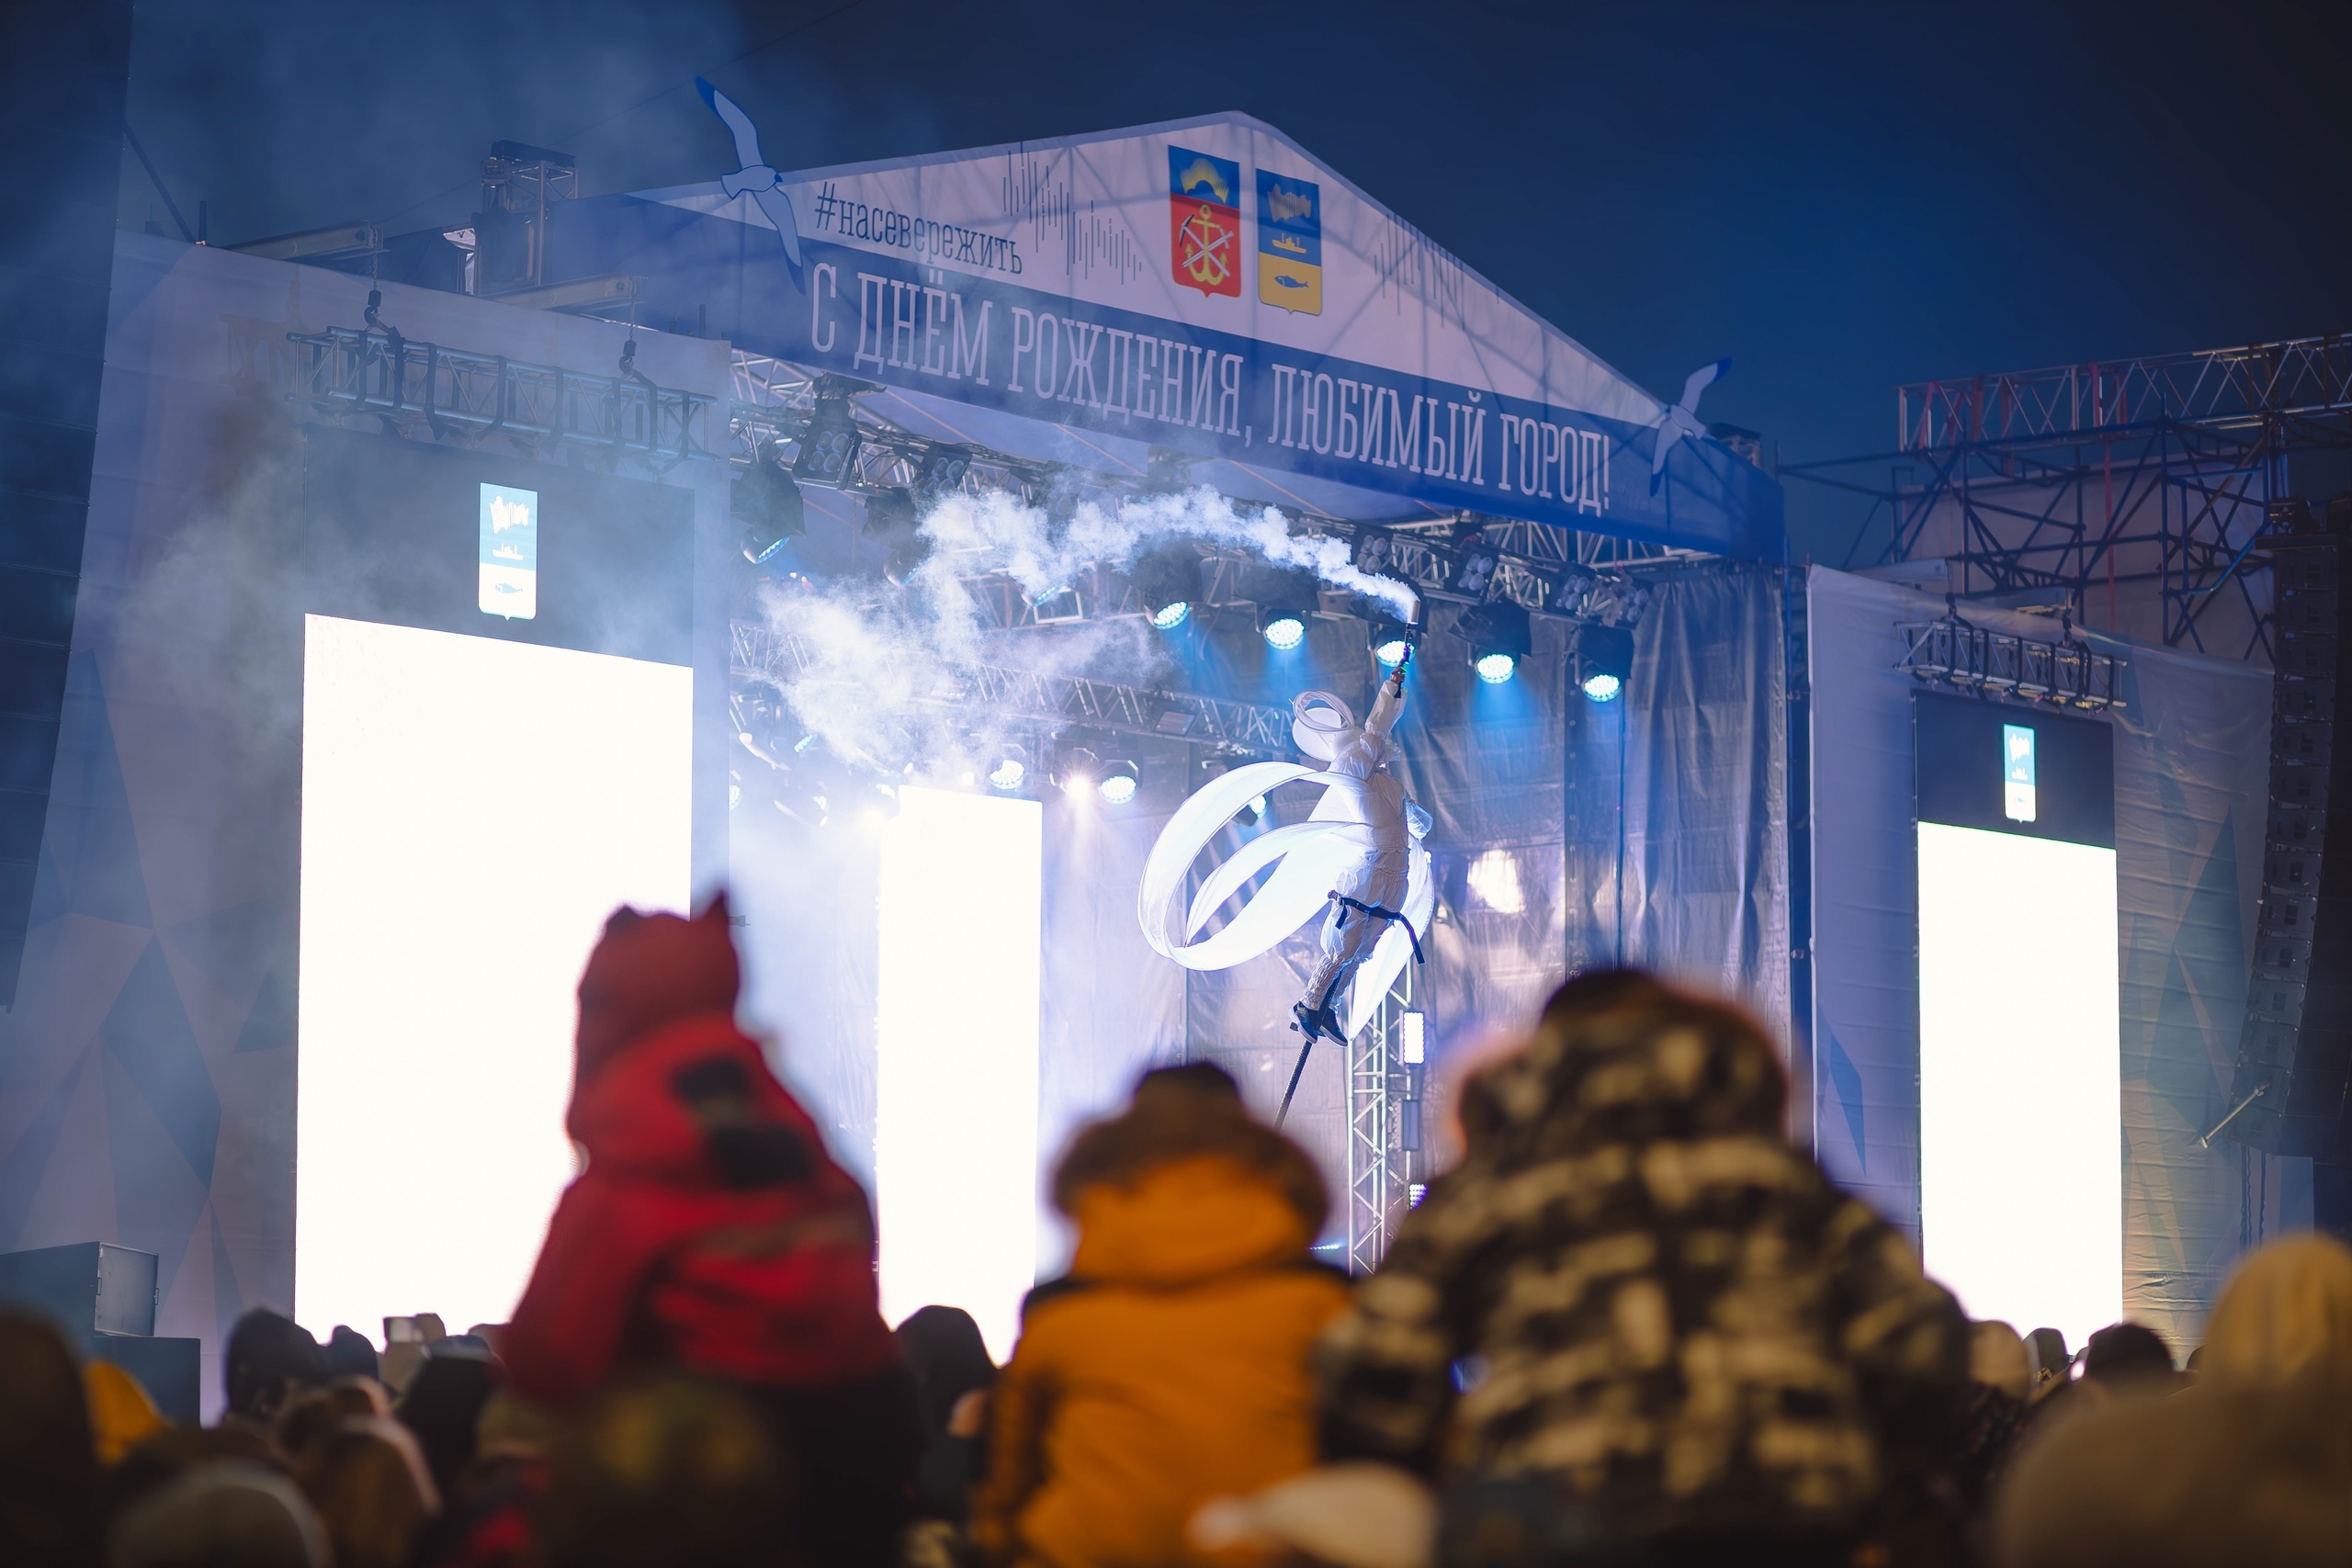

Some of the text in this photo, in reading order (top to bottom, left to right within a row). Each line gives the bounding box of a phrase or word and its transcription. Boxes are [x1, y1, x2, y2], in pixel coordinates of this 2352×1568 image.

[814, 181, 1023, 275] #насевережить
[811, 263, 1610, 518] С ДНЁМ РОЖДЕНИЯ, ЛЮБИМЫЙ ГОРОД!
